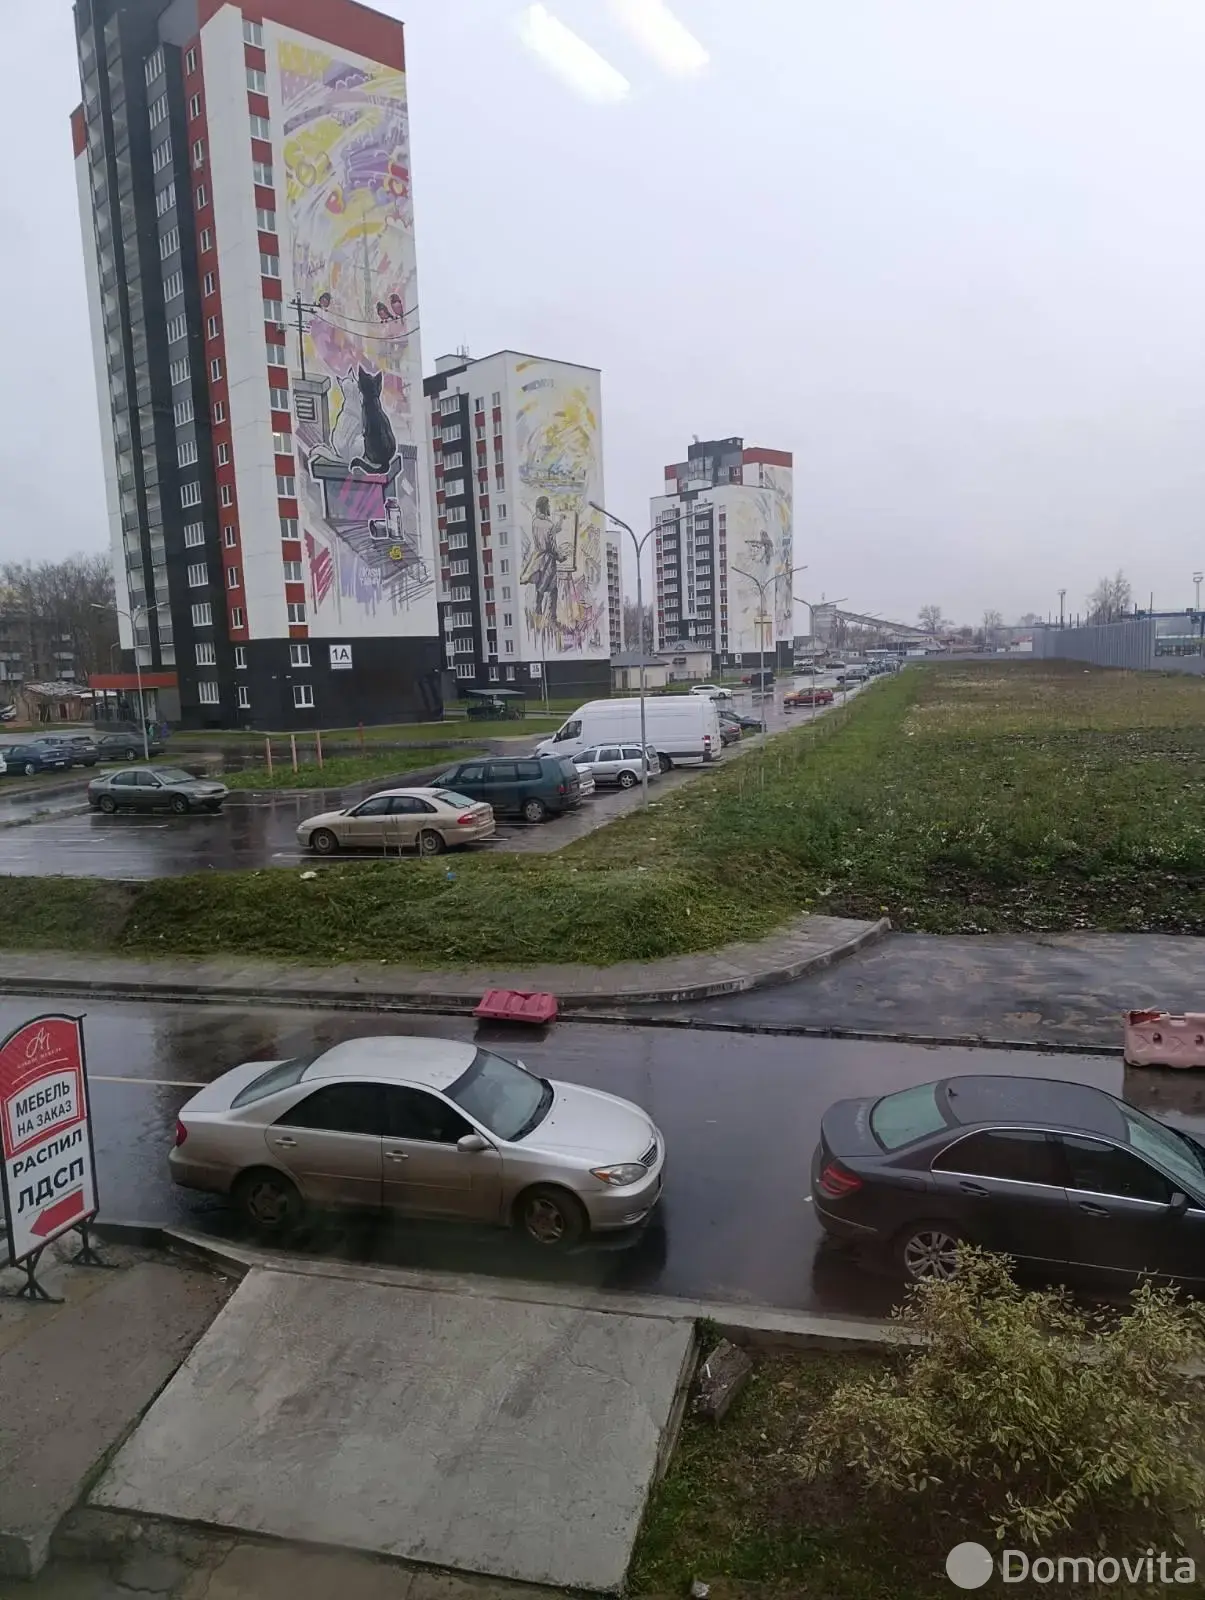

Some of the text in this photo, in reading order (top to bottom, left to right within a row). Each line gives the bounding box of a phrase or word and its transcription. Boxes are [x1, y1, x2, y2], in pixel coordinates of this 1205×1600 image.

[16, 1081, 70, 1118] МЕБЕЛЬ
[17, 1100, 72, 1137] НА ЗАКАЗ
[12, 1128, 82, 1178] РАСПИЛ
[17, 1157, 84, 1214] ЛДСП
